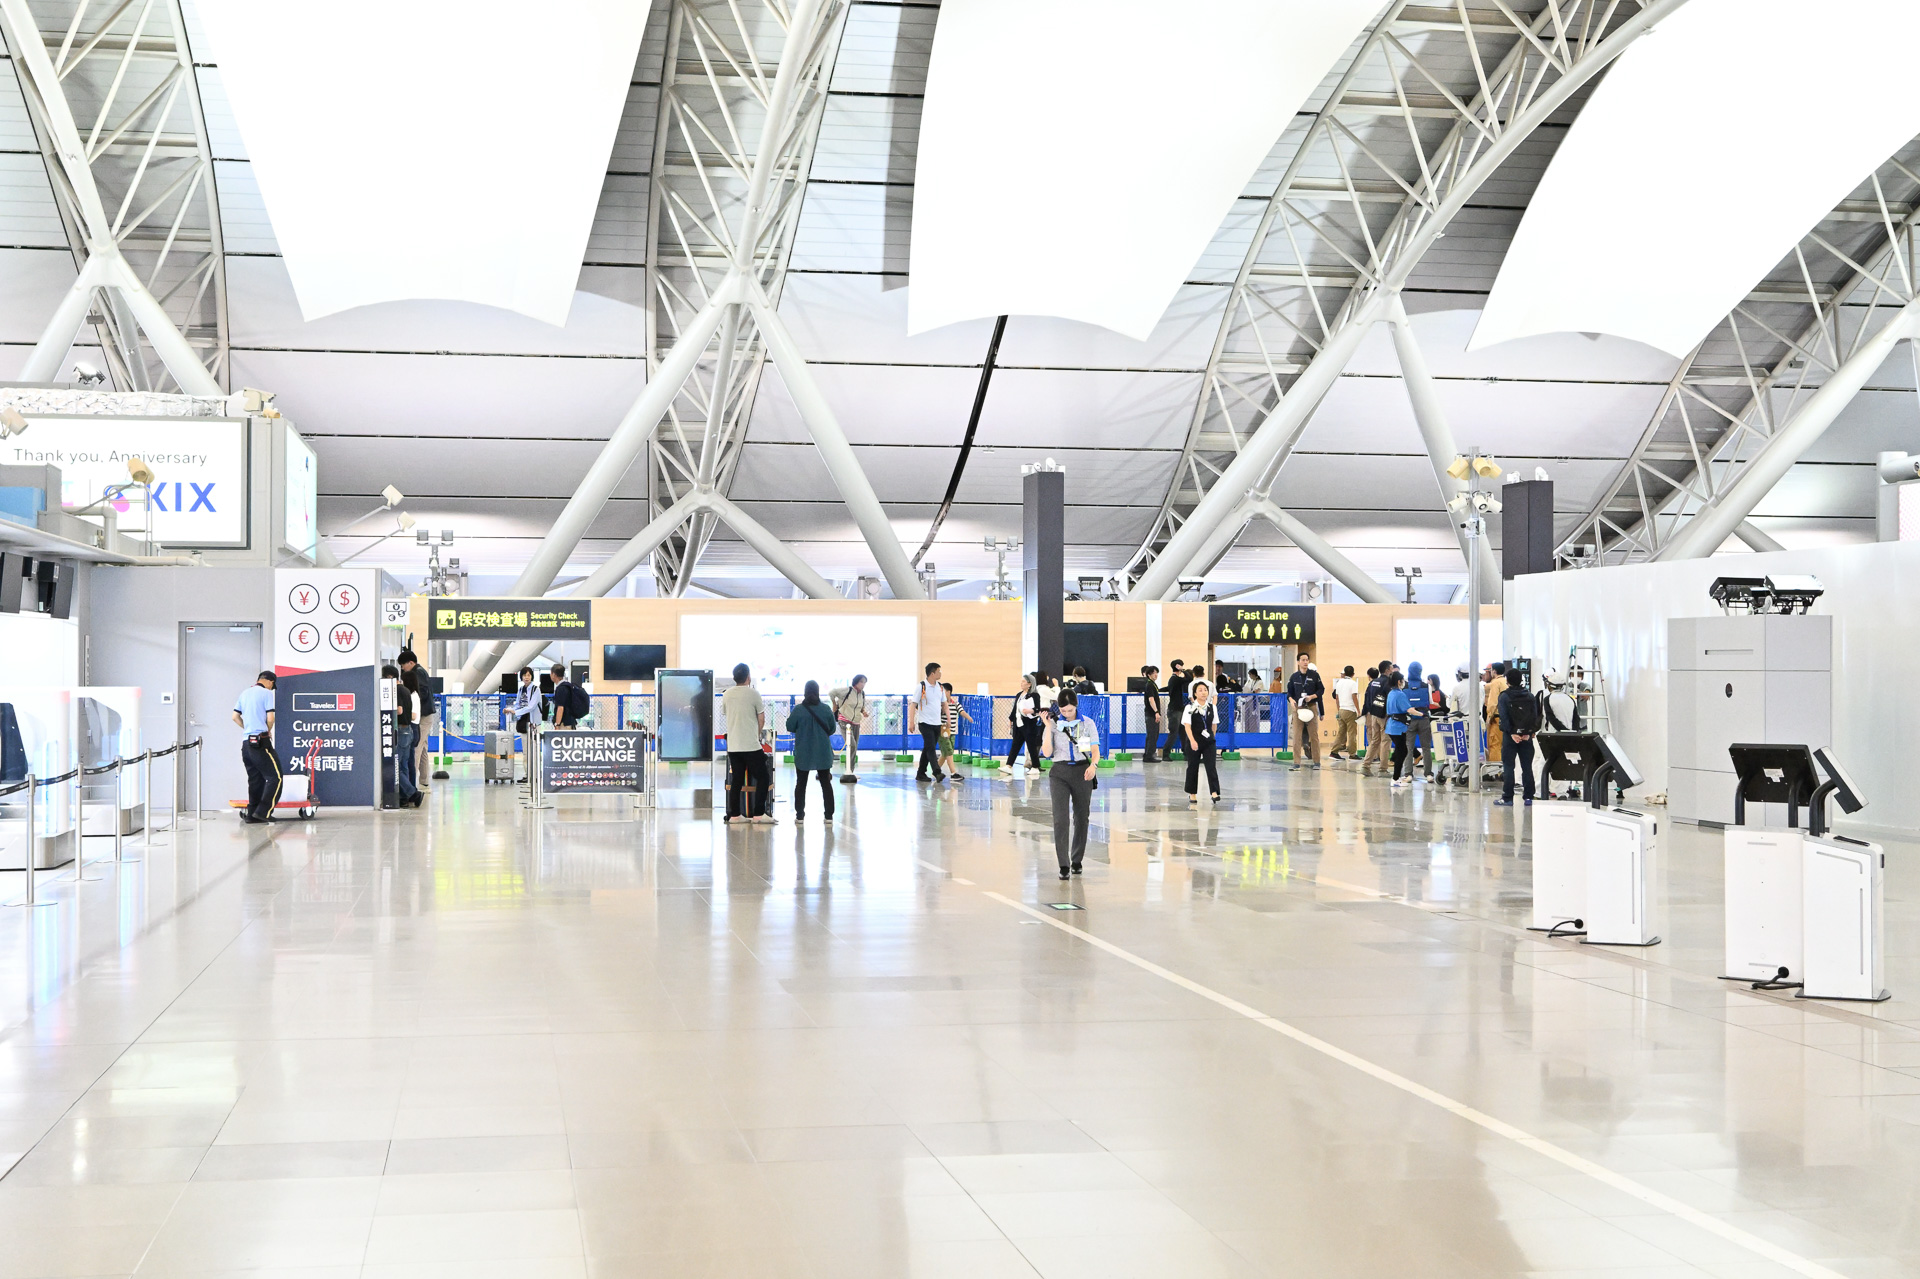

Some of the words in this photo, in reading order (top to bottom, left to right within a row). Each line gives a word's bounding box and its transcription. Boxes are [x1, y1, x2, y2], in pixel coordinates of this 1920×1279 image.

[13, 448, 64, 462] Thank
[144, 482, 217, 513] KIX
[340, 589, 350, 608] $
[458, 611, 528, 628] 保安検査場
[530, 611, 557, 621] Security
[557, 611, 578, 620] Check
[1237, 609, 1261, 621] Fast
[1262, 609, 1289, 621] Lane
[292, 720, 354, 734] Currency
[551, 736, 637, 749] CURRENCY
[1456, 729, 1465, 755] DHC
[551, 749, 636, 762] EXCHANGE
